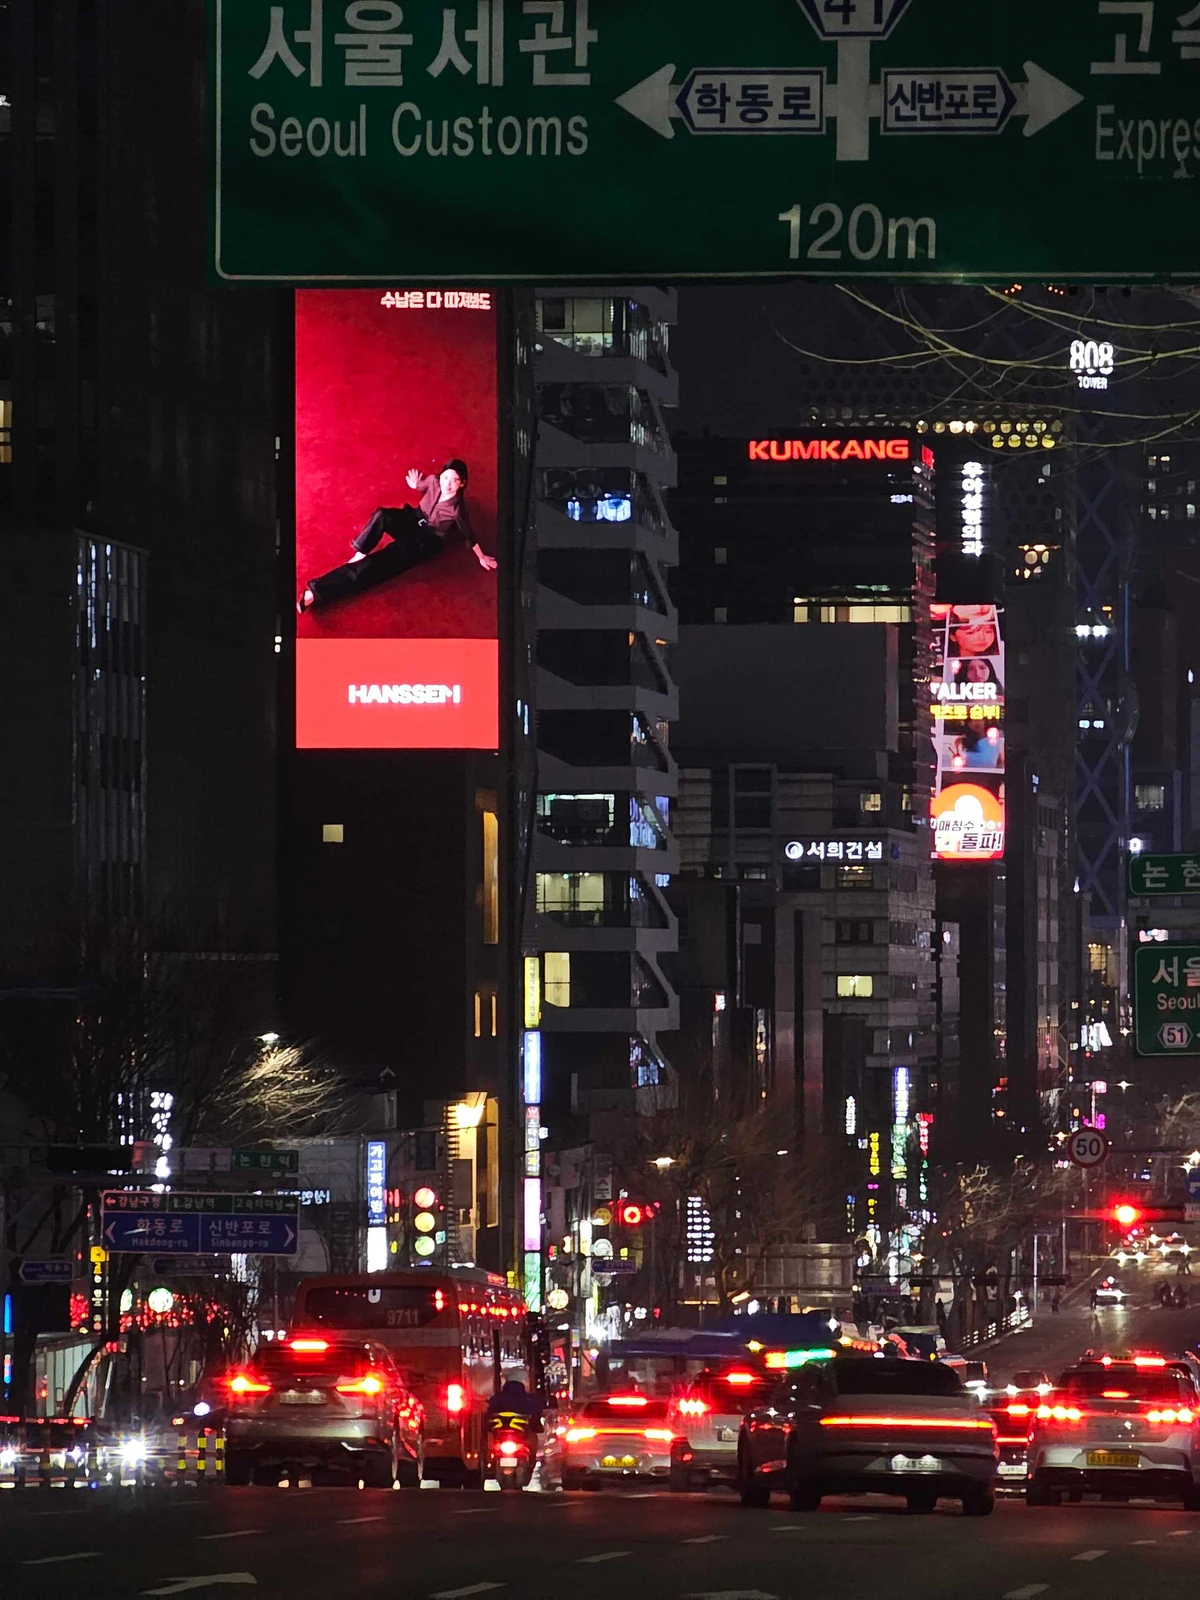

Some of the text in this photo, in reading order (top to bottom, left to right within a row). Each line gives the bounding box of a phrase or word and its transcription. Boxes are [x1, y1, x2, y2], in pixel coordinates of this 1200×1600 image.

[248, 0, 598, 87] 서울세관
[694, 83, 817, 124] 학동로
[888, 81, 999, 121] 신반포로
[249, 102, 588, 157] Seoul Customs
[778, 203, 937, 260] 120m
[426, 291, 443, 308] 다
[1069, 339, 1114, 375] 808
[1077, 376, 1108, 389] TOWER
[749, 439, 909, 461] KUMKANG
[348, 684, 461, 704] HANSSEM
[961, 832, 1002, 850] 돌파!
[806, 841, 883, 860] 서희건설
[1166, 1027, 1185, 1044] 51
[1075, 1138, 1100, 1157] 50
[239, 1154, 291, 1167] 논현역
[118, 1196, 160, 1209] 강남구청
[183, 1197, 215, 1209] 강남역
[234, 1198, 284, 1211] 고속터미널
[136, 1217, 185, 1235] 학동로
[208, 1219, 273, 1237] 신반포로
[131, 1237, 189, 1249] Hakdong-ro
[210, 1238, 270, 1249] Sinbanpo-ro
[387, 1308, 420, 1326] 9711
